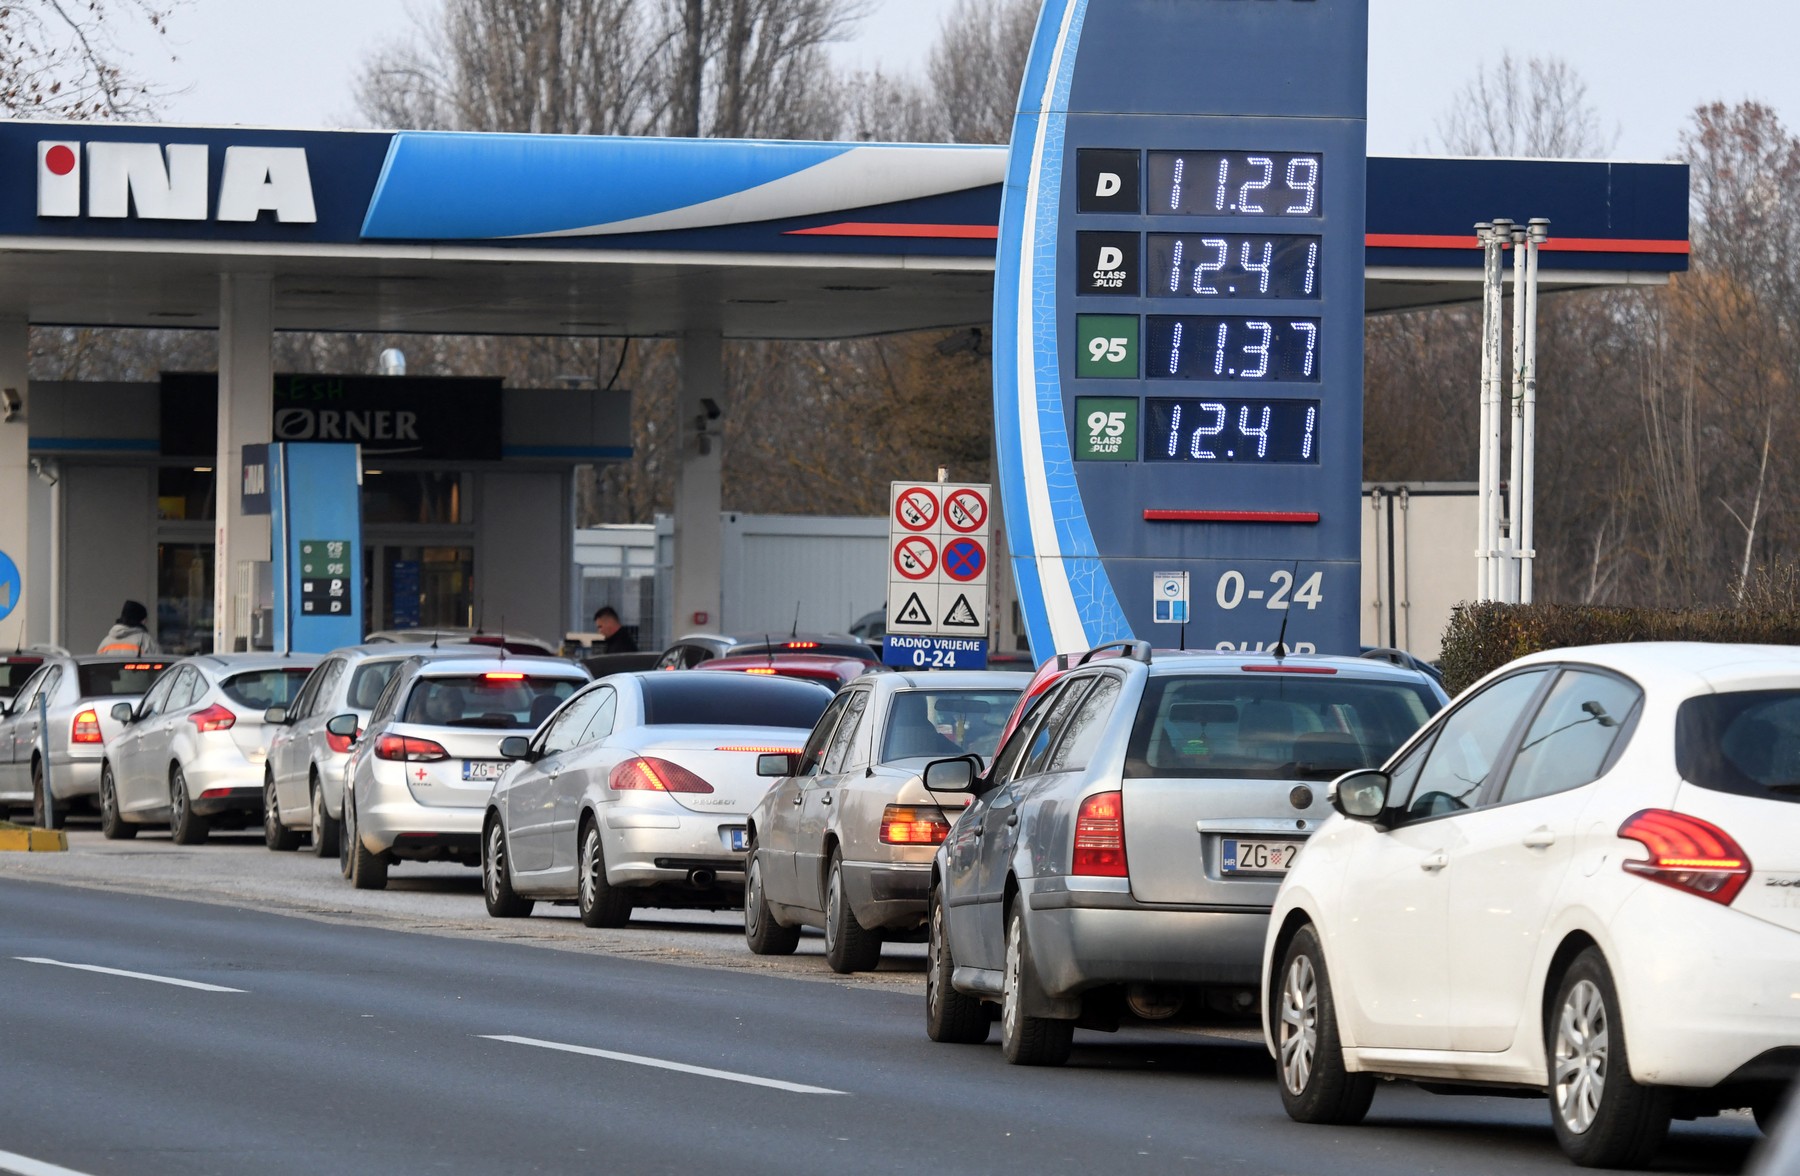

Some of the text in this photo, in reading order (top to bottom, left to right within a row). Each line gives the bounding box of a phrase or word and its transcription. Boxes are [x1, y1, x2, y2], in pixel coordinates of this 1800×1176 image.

[37, 140, 317, 223] INA
[1095, 172, 1122, 197] D
[1171, 158, 1318, 213] 11.29
[1097, 246, 1123, 271] D
[1170, 239, 1317, 294] 12.41
[1093, 271, 1126, 280] CLASS
[1096, 279, 1123, 287] PLUS
[1088, 337, 1128, 362] 95
[1169, 321, 1317, 377] 11.37
[1087, 411, 1127, 437] 95
[1168, 403, 1315, 459] 12.41
[1090, 436, 1122, 445] CLASS
[1093, 444, 1119, 453] PLUS
[327, 563, 343, 575] 95
[1216, 570, 1323, 610] 0-24
[330, 601, 342, 612] D
[890, 637, 980, 651] RADNO VRIJEME
[913, 649, 956, 668] 0-24
[472, 763, 488, 777] ZG
[1224, 858, 1236, 866] HR
[1240, 844, 1267, 868] ZG
